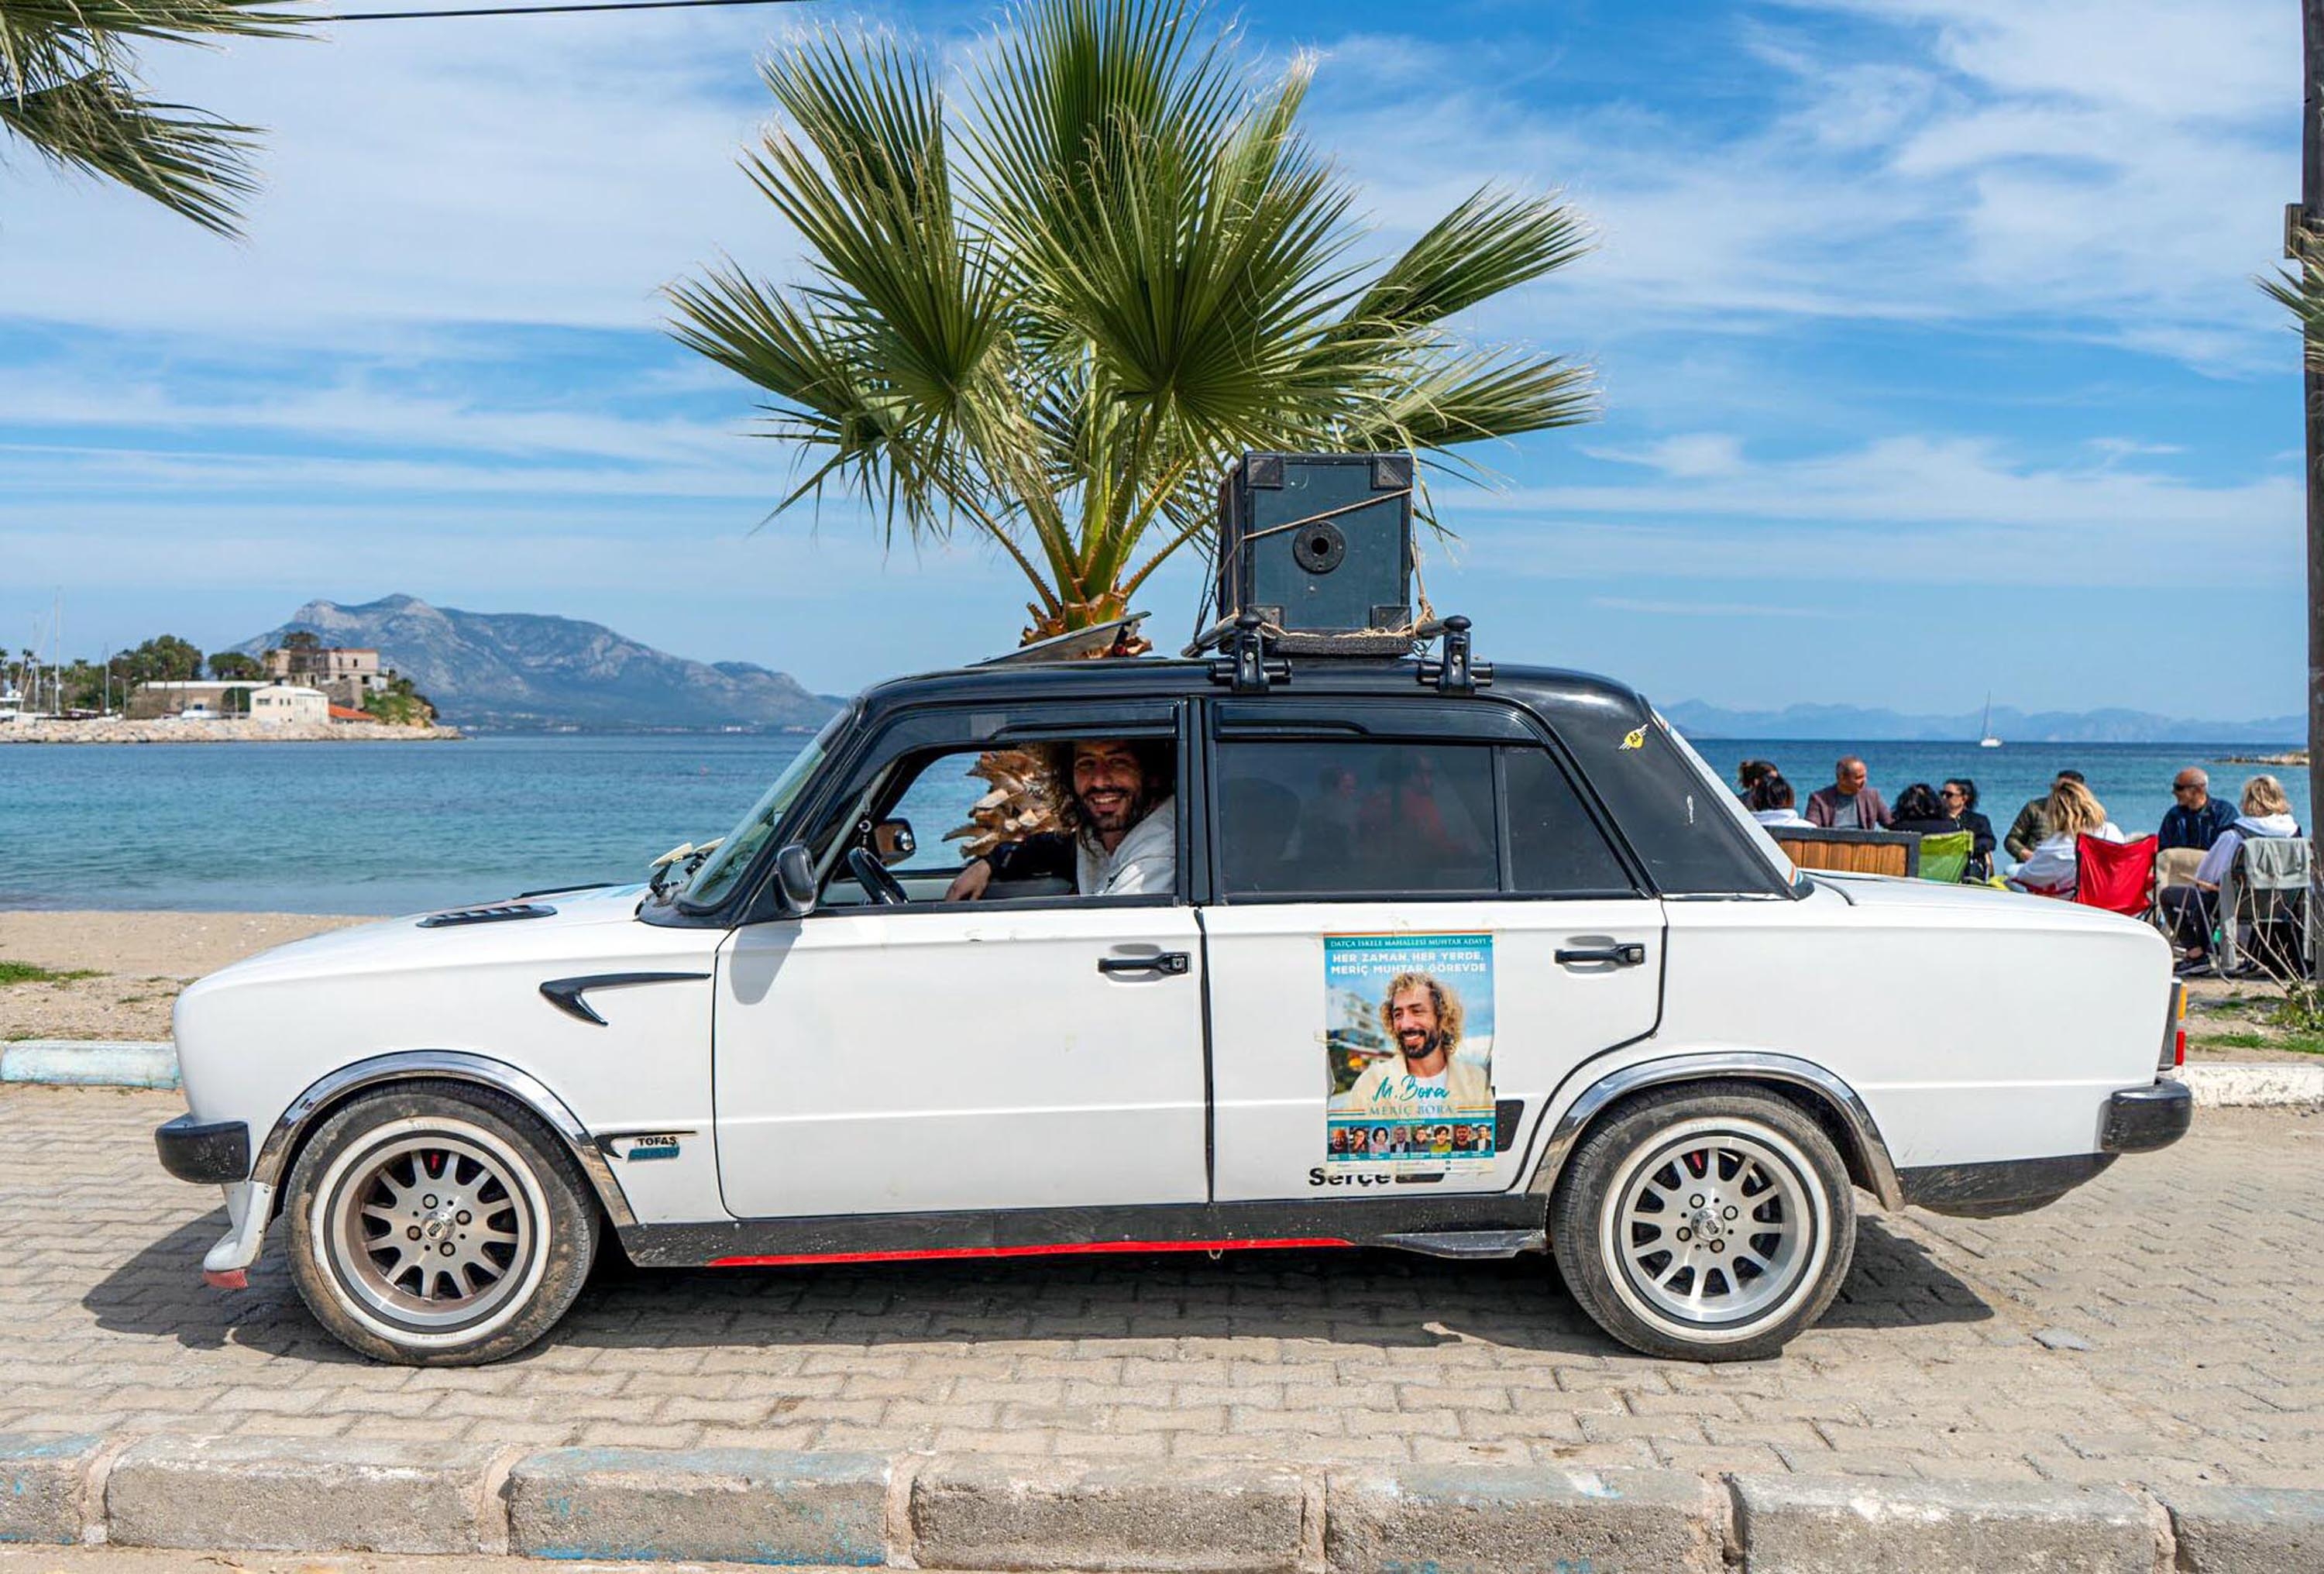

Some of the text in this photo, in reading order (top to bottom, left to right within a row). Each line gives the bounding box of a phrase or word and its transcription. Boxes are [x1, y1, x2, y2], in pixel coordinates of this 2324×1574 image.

[1332, 954, 1357, 963] HER
[1412, 952, 1435, 961] HER
[1441, 951, 1483, 961] YERDE,
[1331, 961, 1487, 976] MERİÇ MUHTAR GÖREVDE
[1417, 1105, 1453, 1115] BORA
[638, 1136, 677, 1146] TOFAŞ
